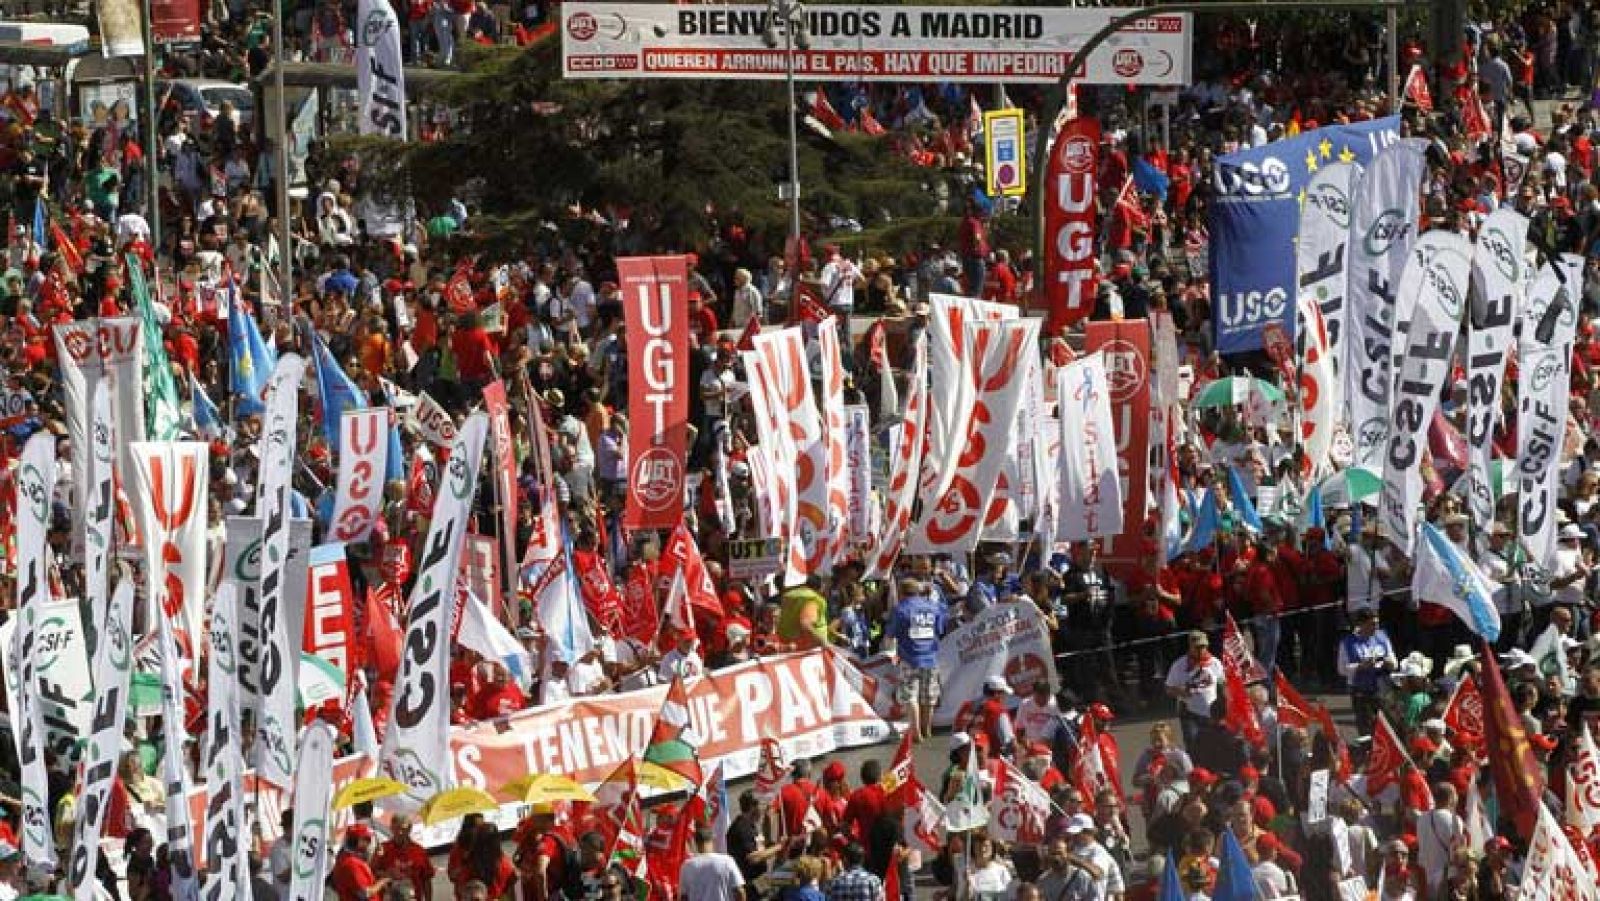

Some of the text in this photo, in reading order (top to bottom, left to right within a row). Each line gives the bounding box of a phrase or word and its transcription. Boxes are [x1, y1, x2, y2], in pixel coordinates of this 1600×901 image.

[890, 13, 911, 37] A
[921, 14, 1043, 39] MADRID
[646, 53, 718, 70] QUIEREN
[812, 54, 831, 71] EL
[884, 54, 923, 73] HAY
[929, 54, 968, 74] QUE
[1214, 156, 1290, 194] USO
[1057, 173, 1093, 309] UGT
[1220, 287, 1286, 326] USO
[638, 283, 675, 446] UGT
[333, 414, 379, 542] USO
